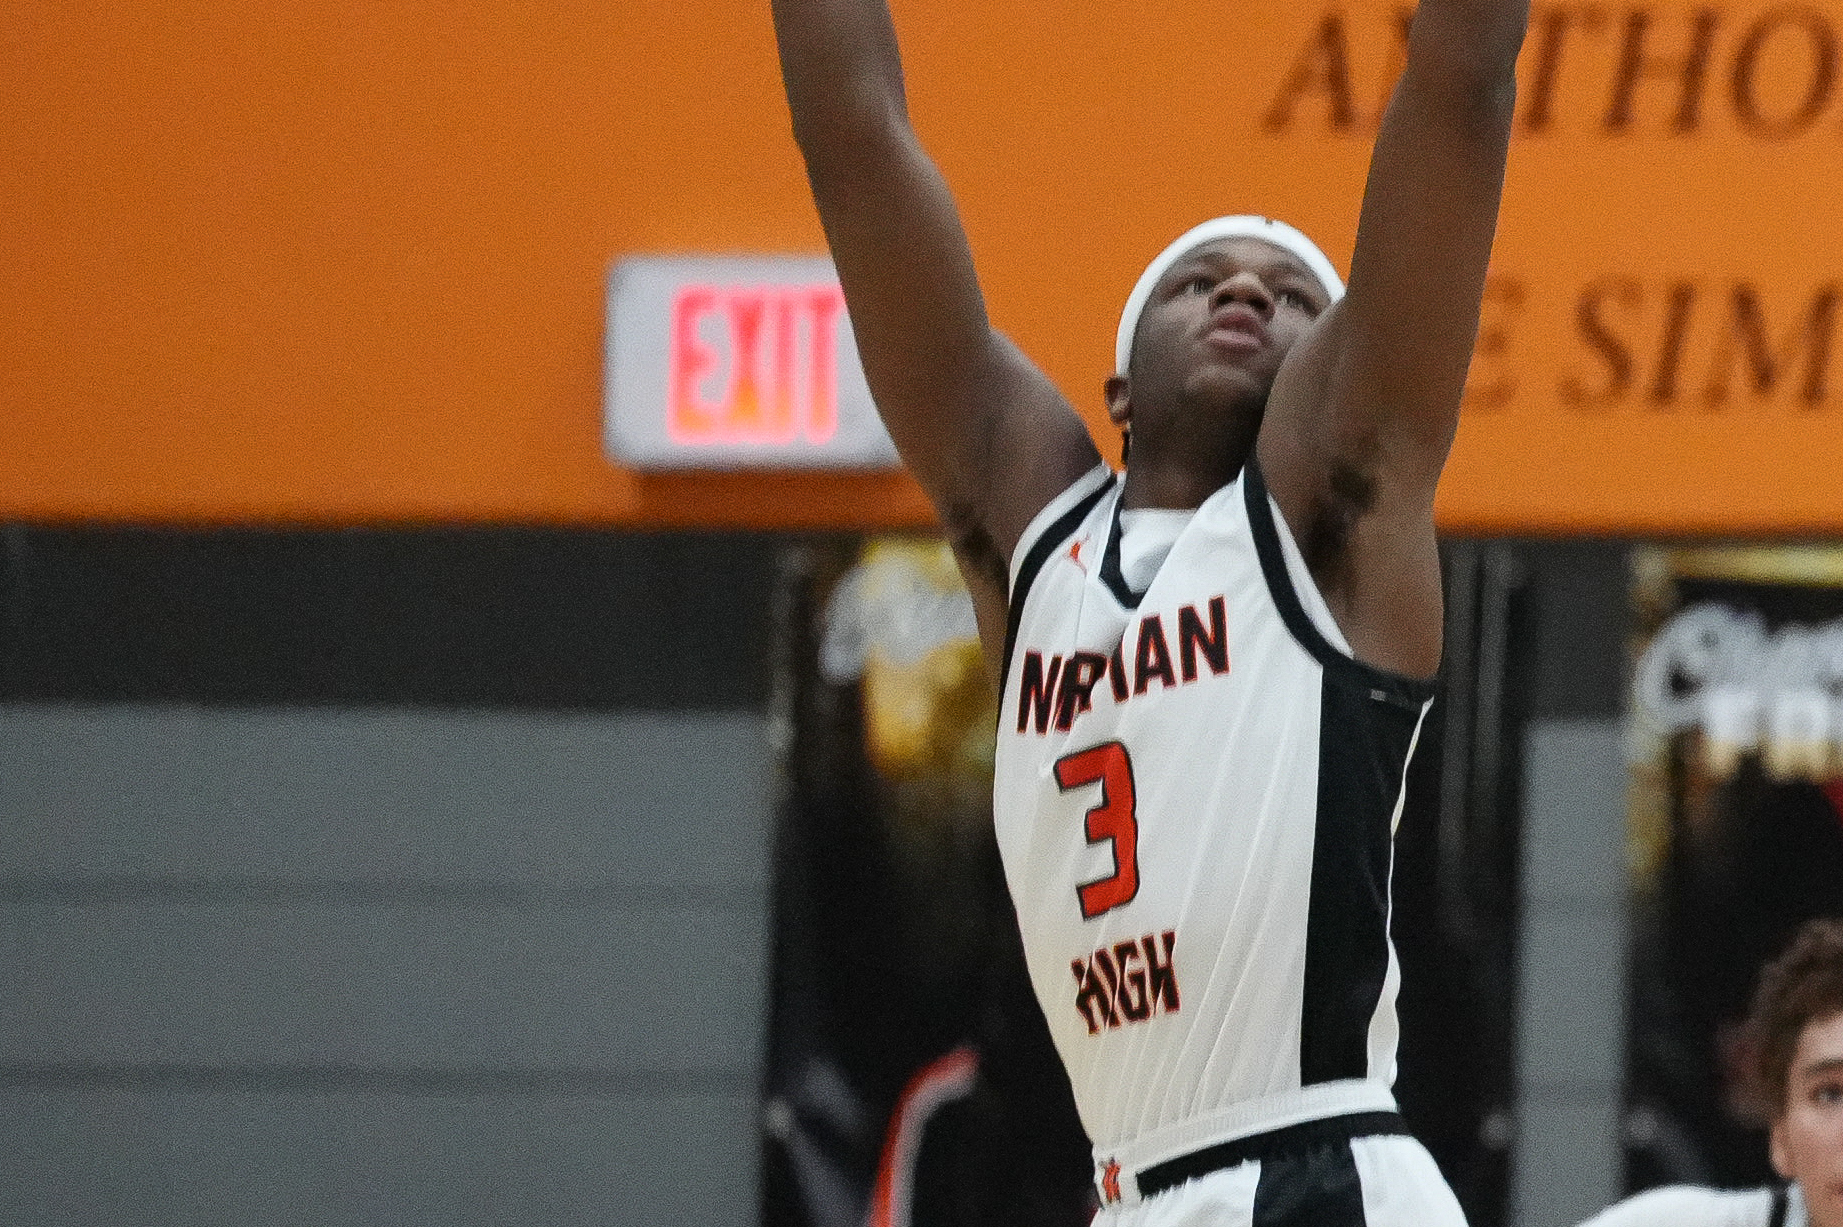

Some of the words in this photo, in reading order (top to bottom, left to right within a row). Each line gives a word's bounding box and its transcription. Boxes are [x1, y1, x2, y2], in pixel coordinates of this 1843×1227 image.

[667, 284, 848, 446] EXIT
[1015, 593, 1231, 737] NRAN
[1052, 739, 1141, 922] 3
[1070, 929, 1181, 1038] HIGH
